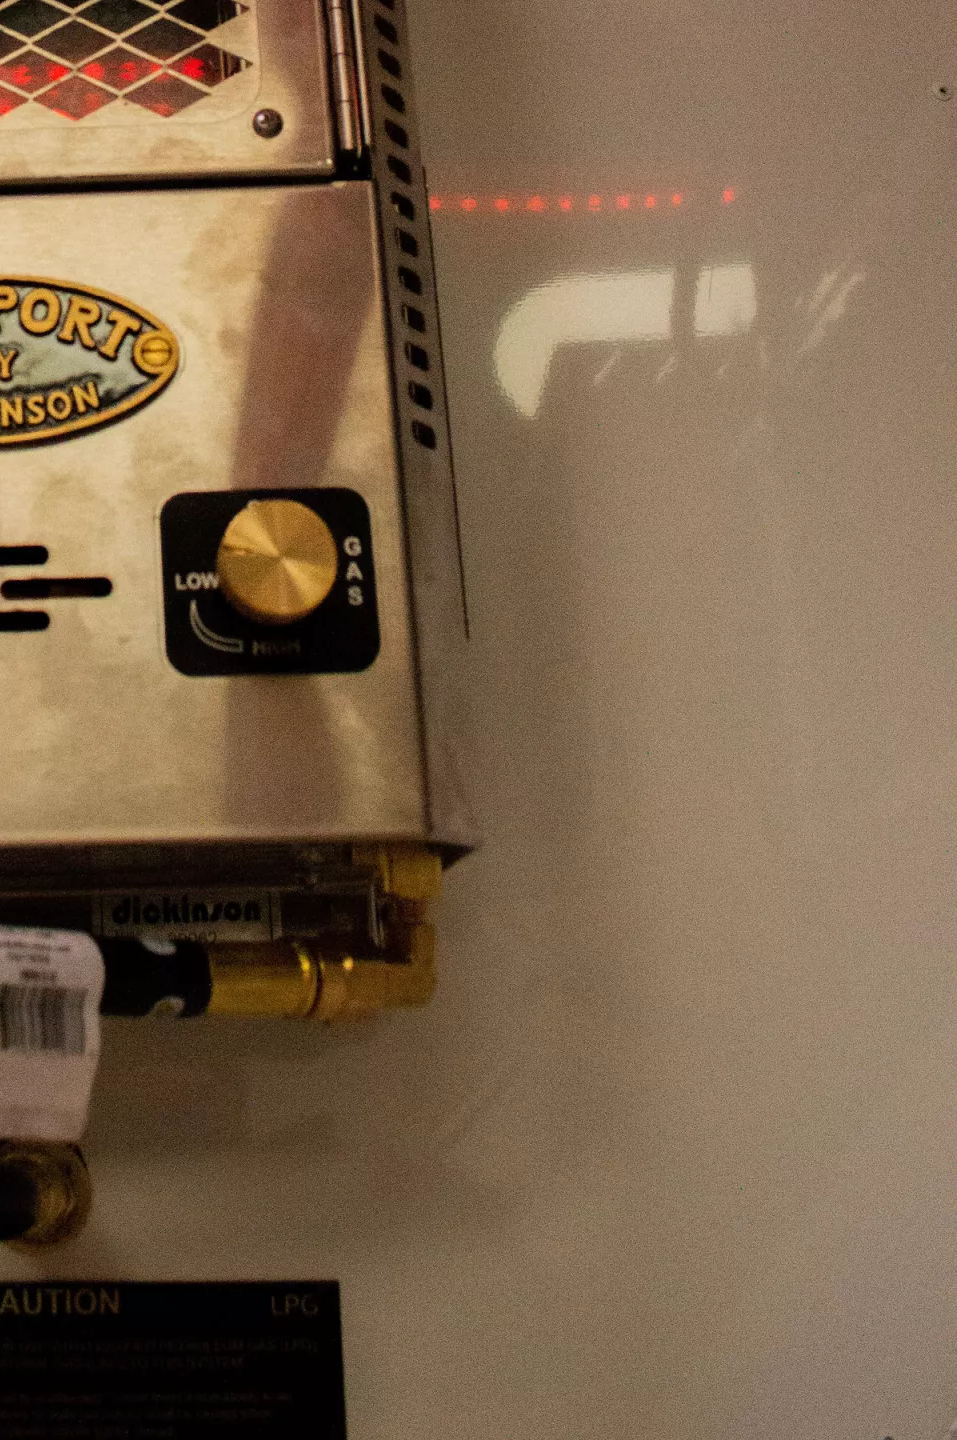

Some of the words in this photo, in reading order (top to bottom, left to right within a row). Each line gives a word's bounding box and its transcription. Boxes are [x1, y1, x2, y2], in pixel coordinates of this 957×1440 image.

[174, 571, 220, 592] LOW
[342, 535, 364, 607] GAS
[111, 894, 261, 925] dickinson
[270, 1292, 320, 1318] LPG
